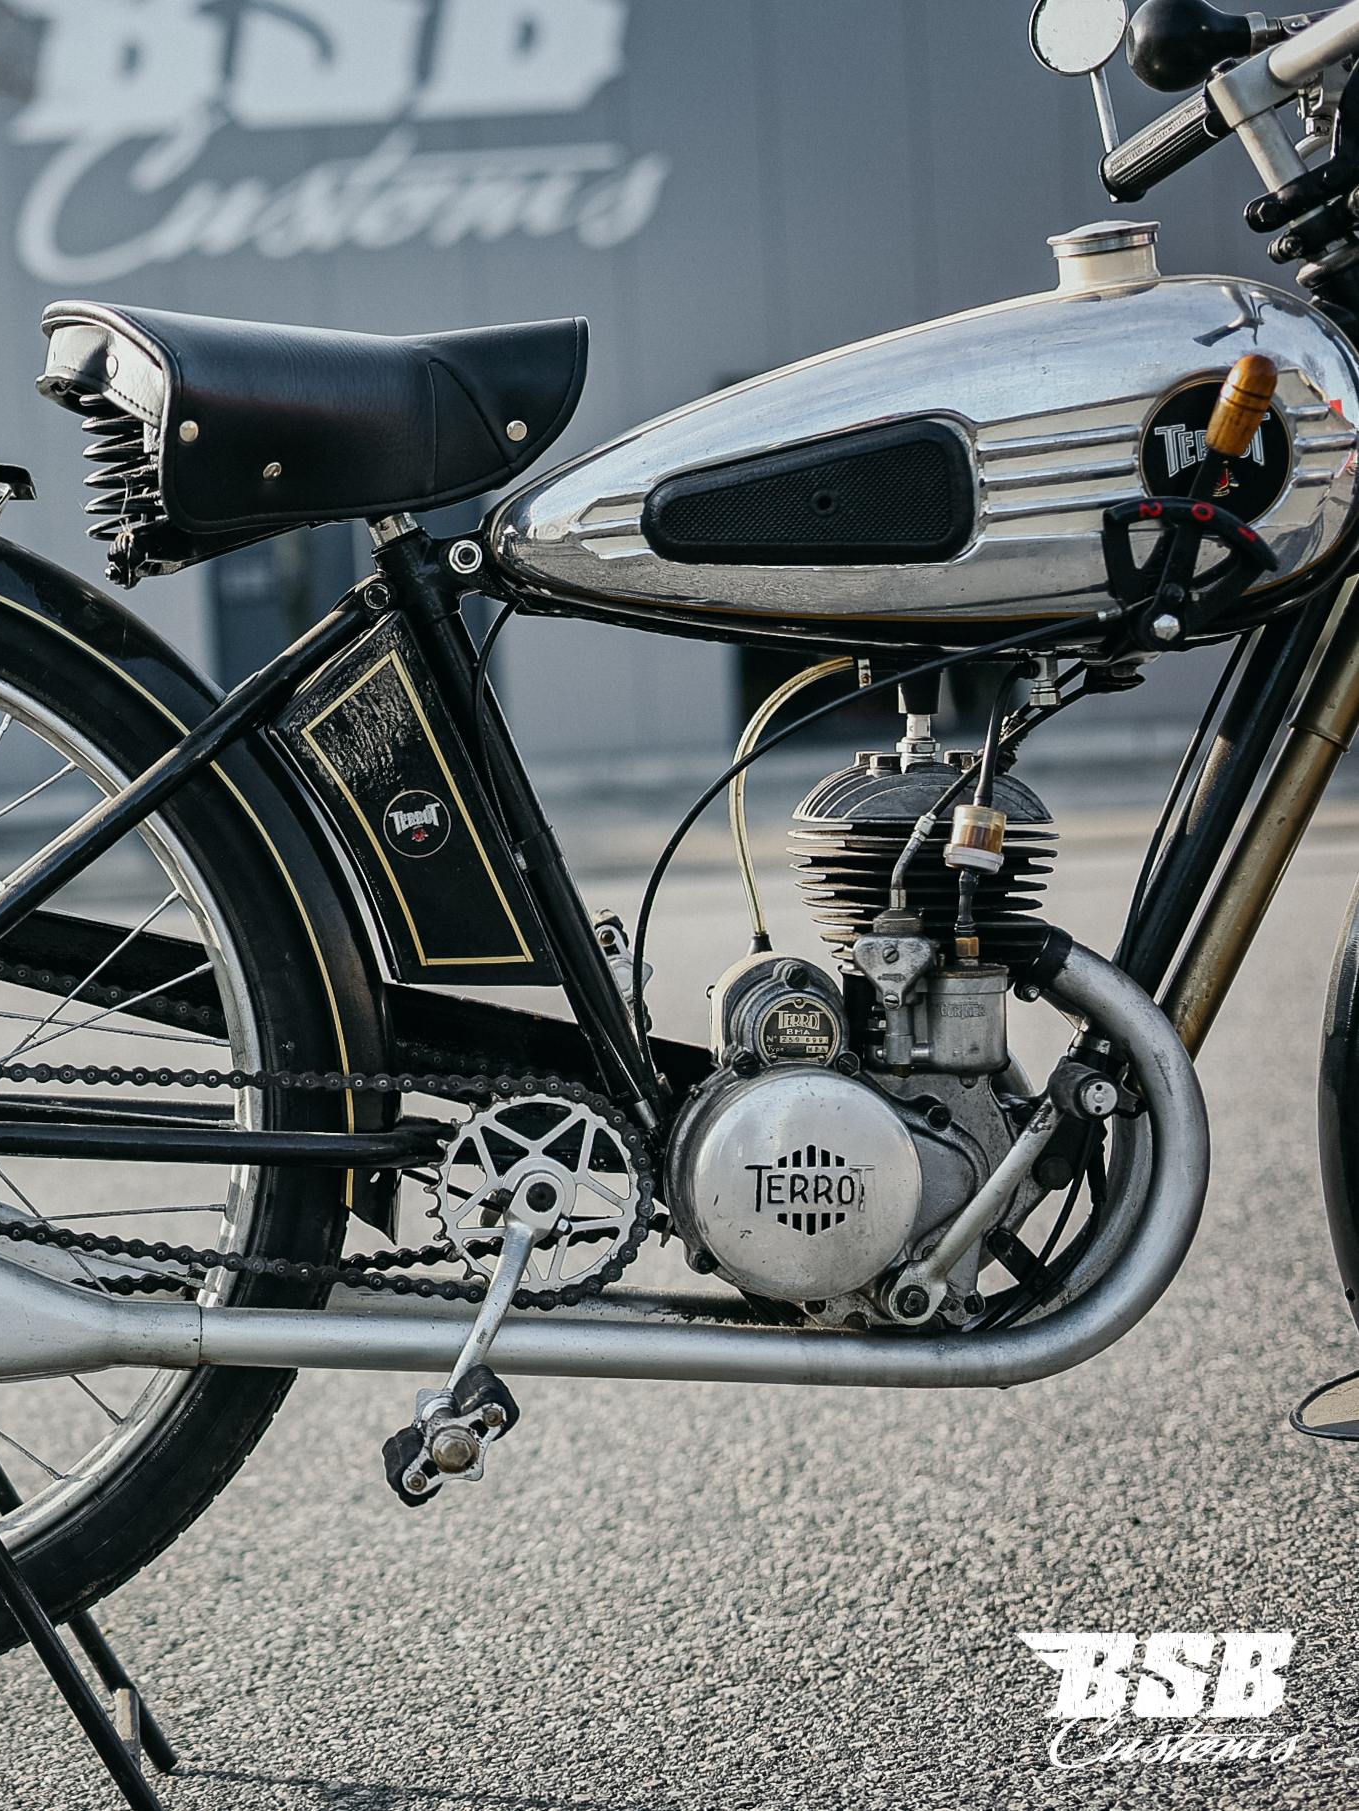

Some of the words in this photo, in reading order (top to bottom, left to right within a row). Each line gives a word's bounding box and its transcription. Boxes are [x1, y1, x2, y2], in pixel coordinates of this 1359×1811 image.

[16, 122, 669, 285] Customs
[1154, 412, 1271, 478] TERT
[388, 802, 441, 836] TERROT
[773, 1010, 824, 1031] TERROT
[786, 1028, 811, 1036] BMA
